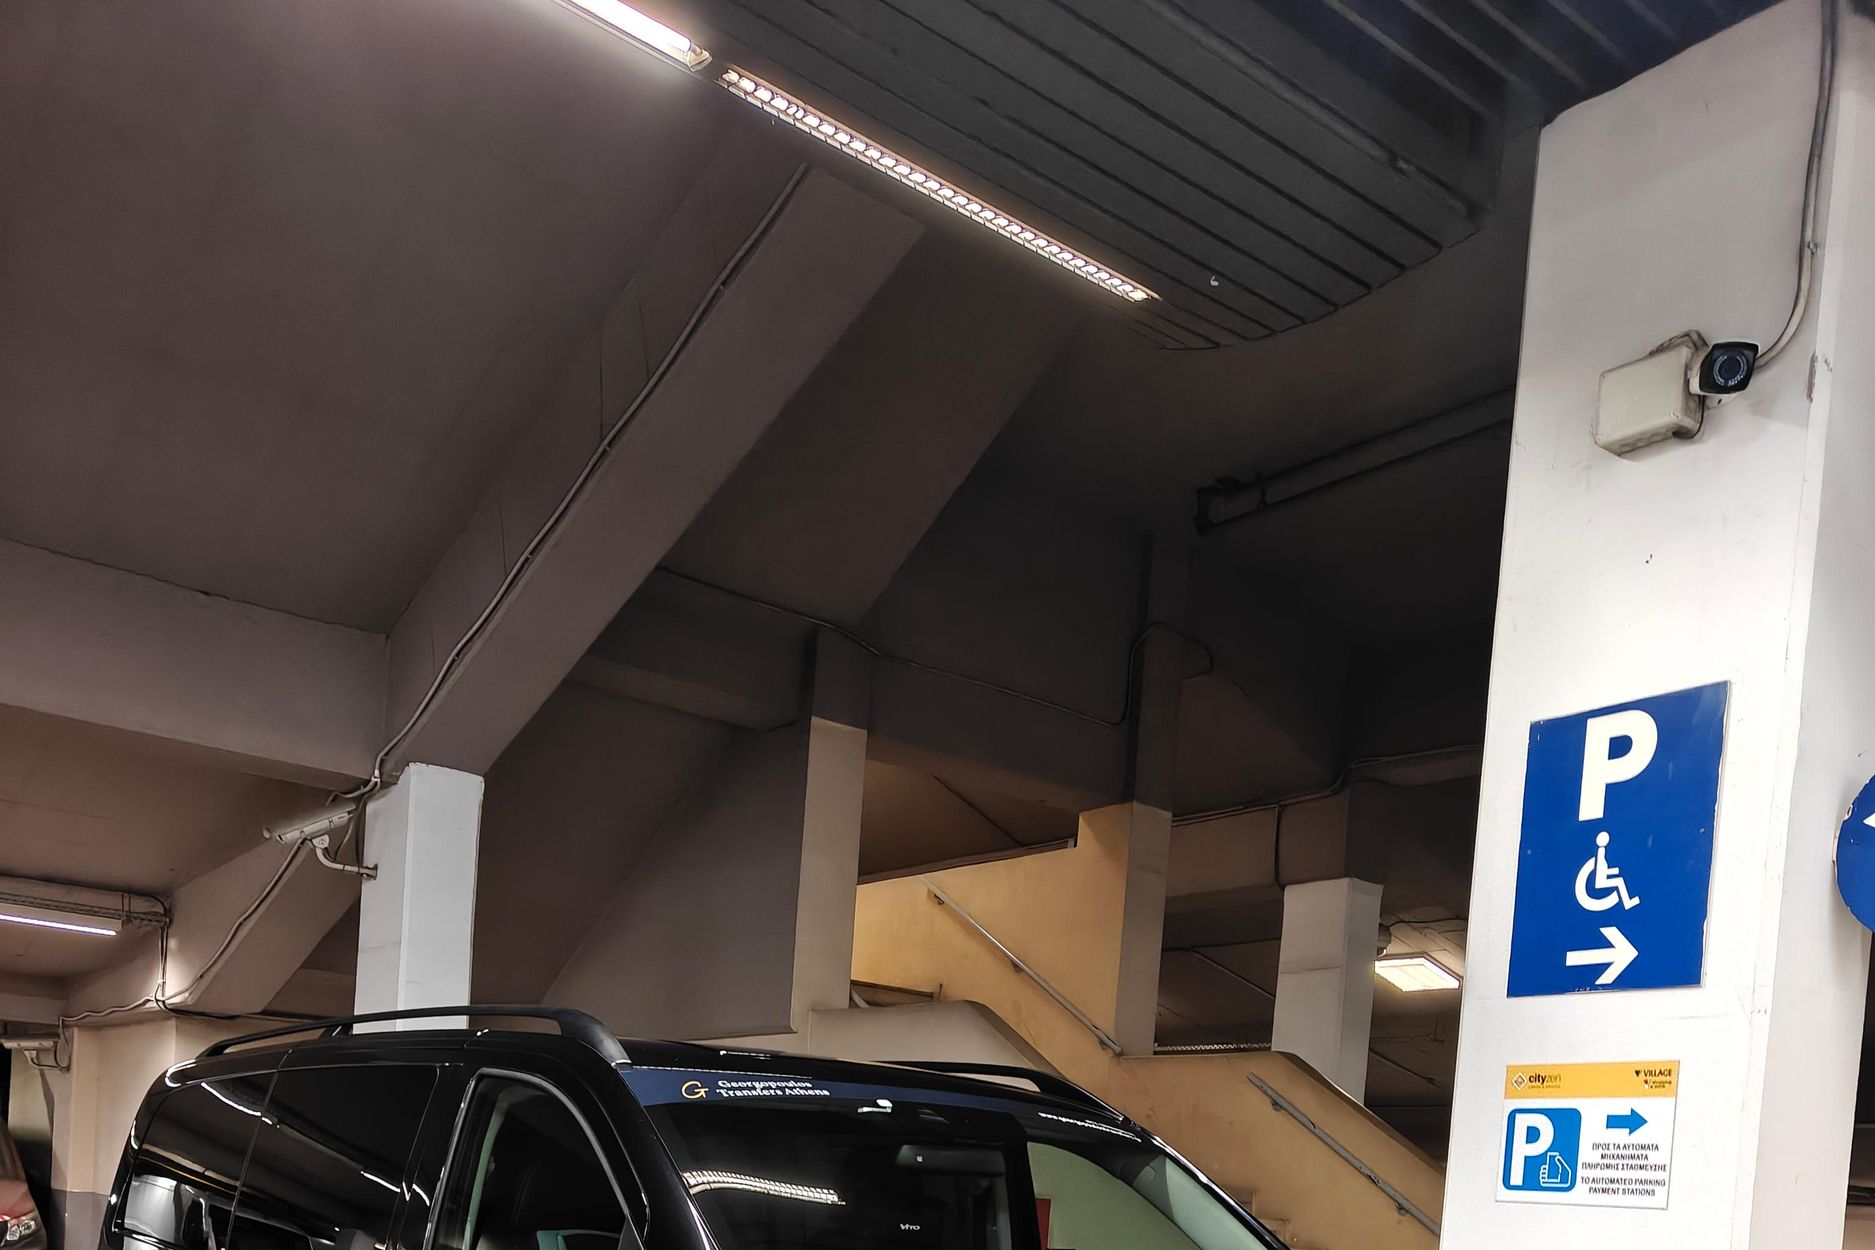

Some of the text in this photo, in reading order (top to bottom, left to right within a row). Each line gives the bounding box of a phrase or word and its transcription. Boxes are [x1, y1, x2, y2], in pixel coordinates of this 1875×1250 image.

[1578, 709, 1659, 822] P
[717, 1079, 813, 1090] Georgopoulos
[715, 1088, 831, 1097] Transfers Athens
[1510, 1112, 1555, 1186] P
[1581, 1176, 1666, 1187] TO AUTOMATED PARKING
[1589, 1187, 1656, 1196] PAYMENT STATIONS
